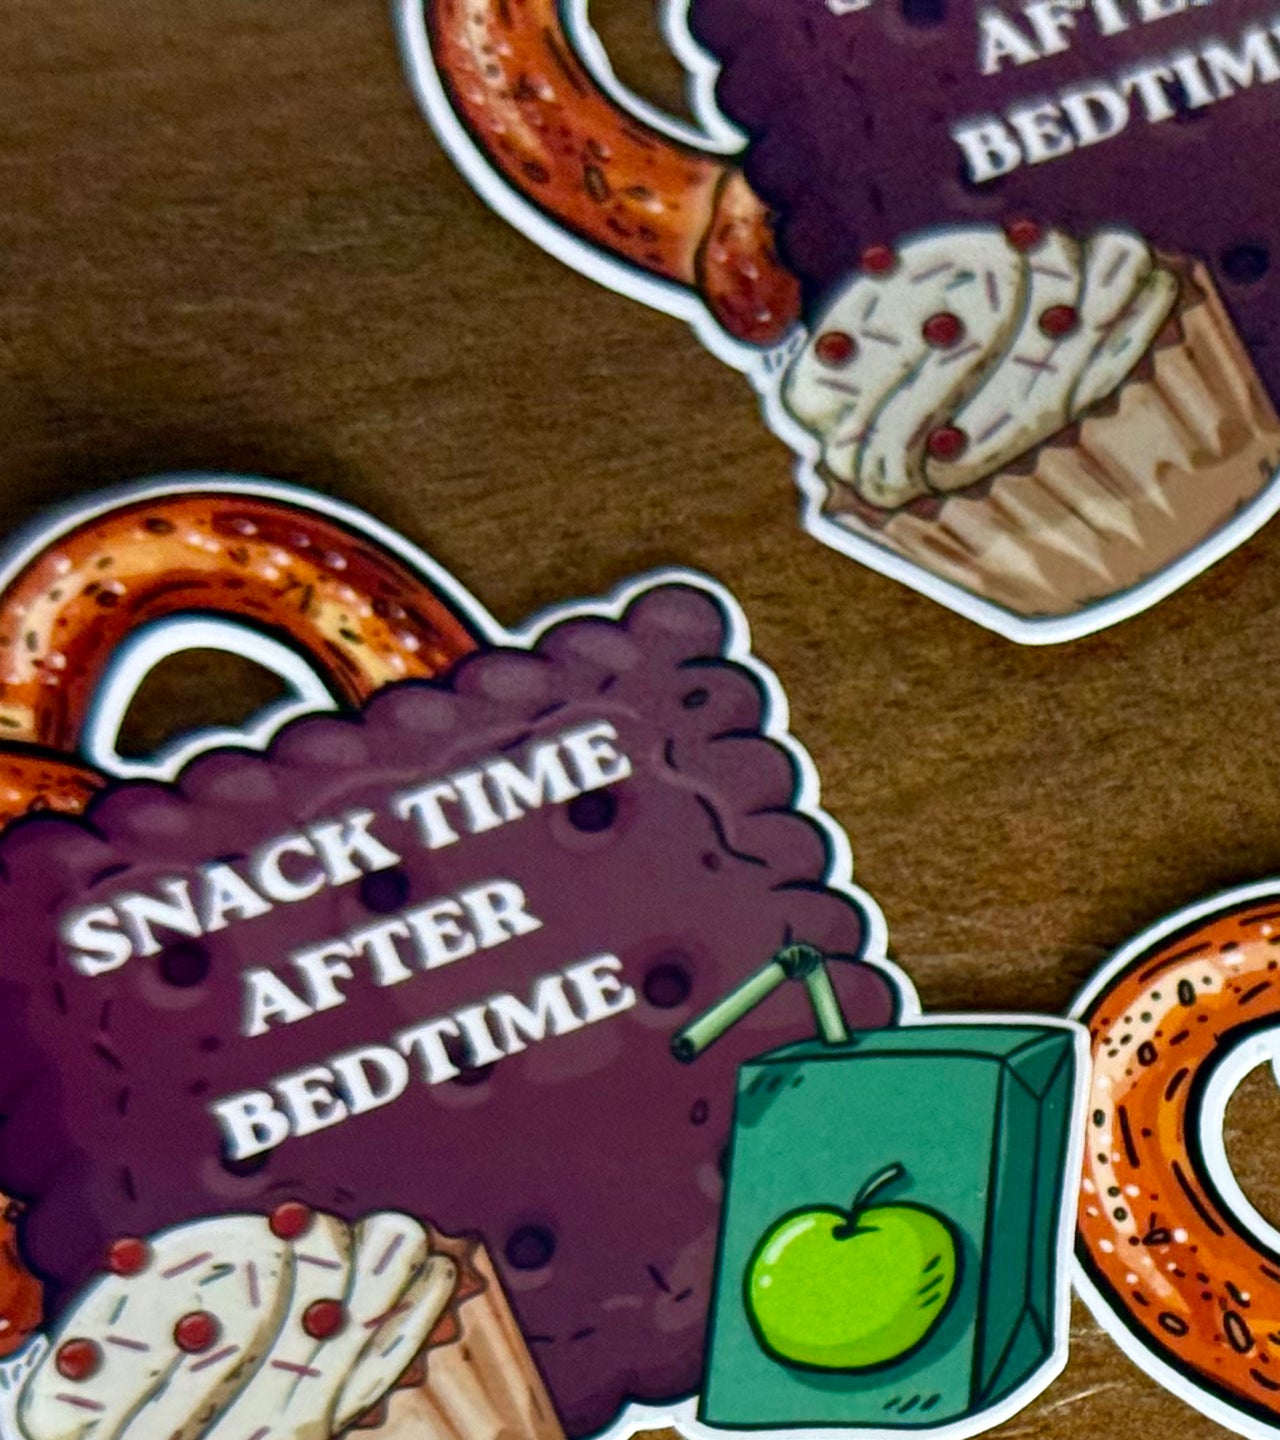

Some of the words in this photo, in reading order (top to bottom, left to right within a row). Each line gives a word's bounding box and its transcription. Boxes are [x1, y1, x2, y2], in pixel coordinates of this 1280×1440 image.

[64, 810, 401, 977] SNACK
[393, 721, 633, 851] TIME
[212, 952, 638, 1161] BEDTIME
[245, 879, 544, 1038] AFTER
